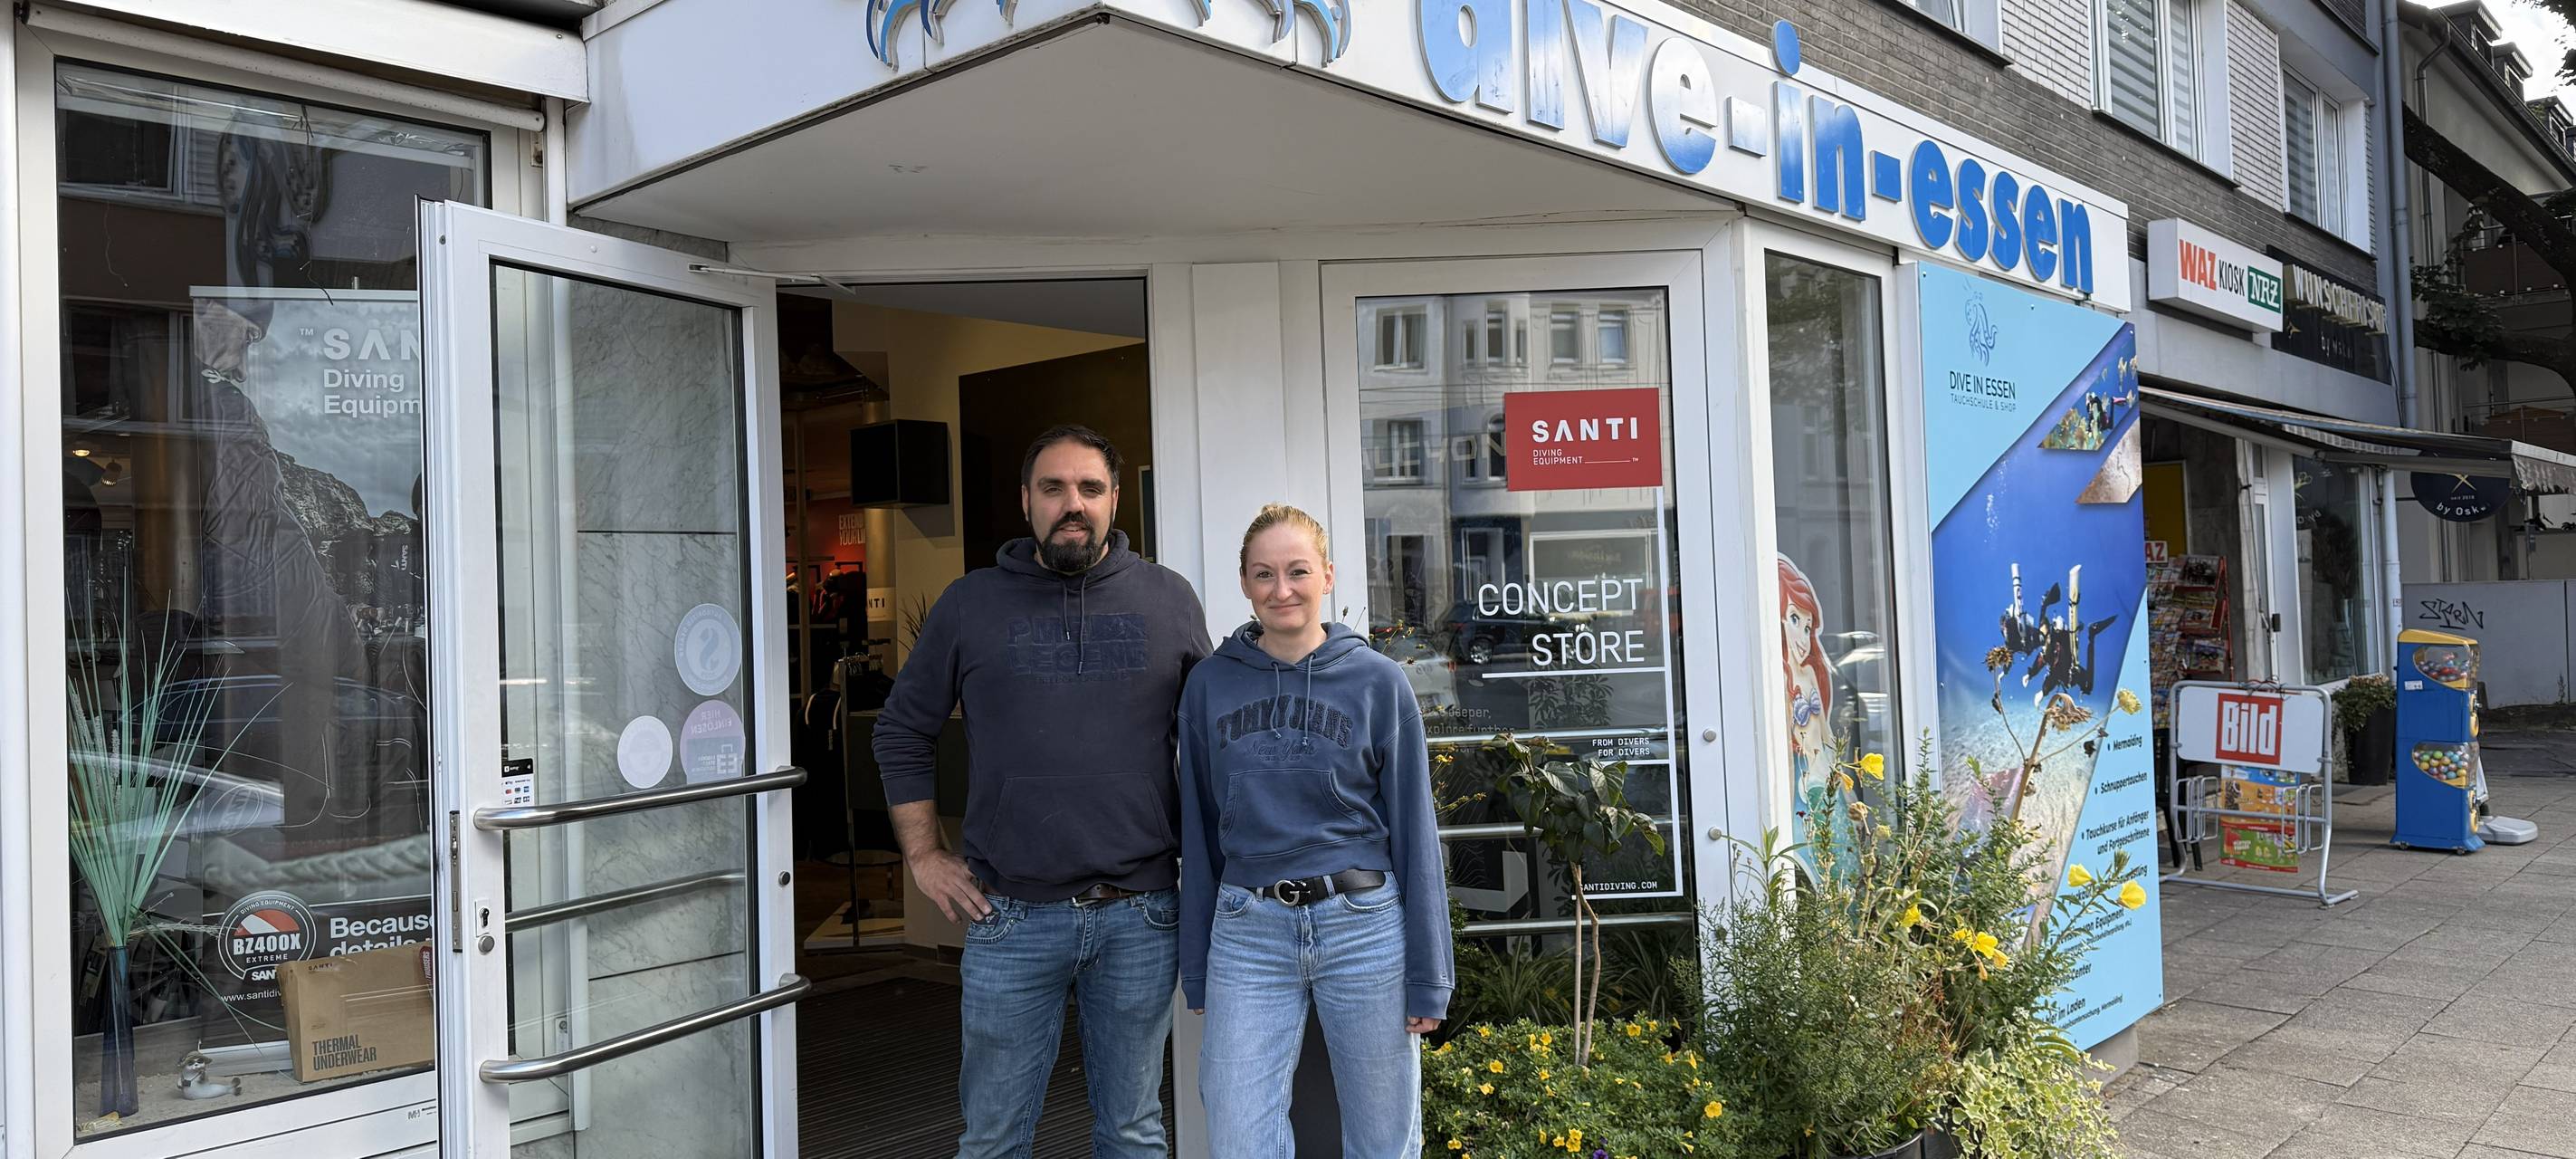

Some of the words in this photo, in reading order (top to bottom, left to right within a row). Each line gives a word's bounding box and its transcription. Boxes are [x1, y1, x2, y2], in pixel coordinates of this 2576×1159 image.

[2180, 239, 2217, 291] WAZ
[2218, 259, 2245, 297] KIOSK
[2249, 272, 2280, 309] NRZ
[323, 369, 405, 393] Diving
[1950, 370, 1971, 393] DIVE
[1973, 375, 1983, 395] IN
[1986, 377, 2016, 399] ESSEN
[324, 395, 421, 418] Equipm
[1951, 393, 1993, 410] TAUCHSCHULE
[2000, 401, 2017, 412] SHOP
[1531, 417, 1638, 443] SANTI
[1532, 448, 1562, 457] DIVING
[1533, 456, 1583, 465] EQUIPMENT
[2437, 503, 2451, 515] by
[2456, 503, 2490, 516] Osk
[1478, 578, 1643, 617] CONCEPT
[1531, 629, 1646, 666] STORE
[2220, 700, 2278, 756] Bild
[1592, 739, 1613, 747] FROM
[1617, 737, 1650, 746] DIVERS
[2113, 733, 2142, 752] Mermaiding
[1598, 749, 1614, 757] FOR
[1618, 748, 1650, 756] DIVERS
[2126, 809, 2150, 827] Anfänger
[2097, 840, 2107, 855] und
[240, 901, 259, 915] DIVING
[261, 899, 295, 911] EQUIPMENT
[234, 933, 301, 956] BZ400X
[246, 953, 289, 963] EXTREME
[2066, 998, 2085, 1015] Laden
[311, 1034, 361, 1056] THERMAL
[312, 1047, 377, 1071] UNDERWEAR
